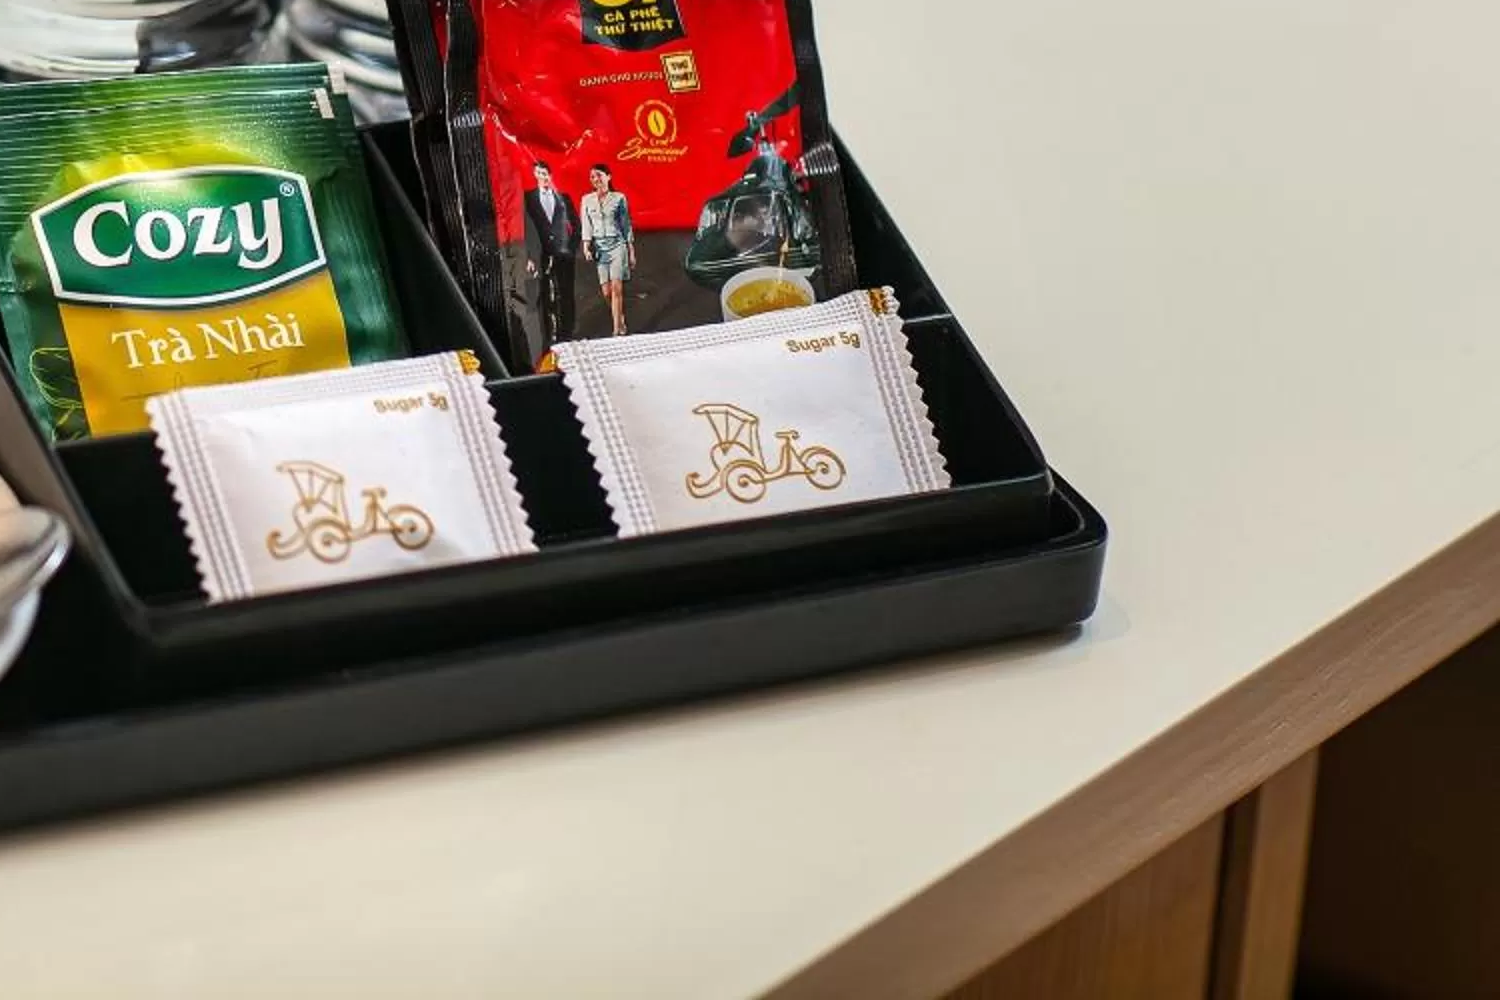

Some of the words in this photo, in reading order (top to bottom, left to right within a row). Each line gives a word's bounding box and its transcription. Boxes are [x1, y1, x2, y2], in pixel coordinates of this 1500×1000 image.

[72, 196, 285, 270] Cozy
[111, 323, 197, 370] Trà
[199, 311, 306, 361] Nhài
[785, 335, 836, 353] Sugar
[838, 330, 861, 349] 5g
[373, 396, 424, 413] Sugar
